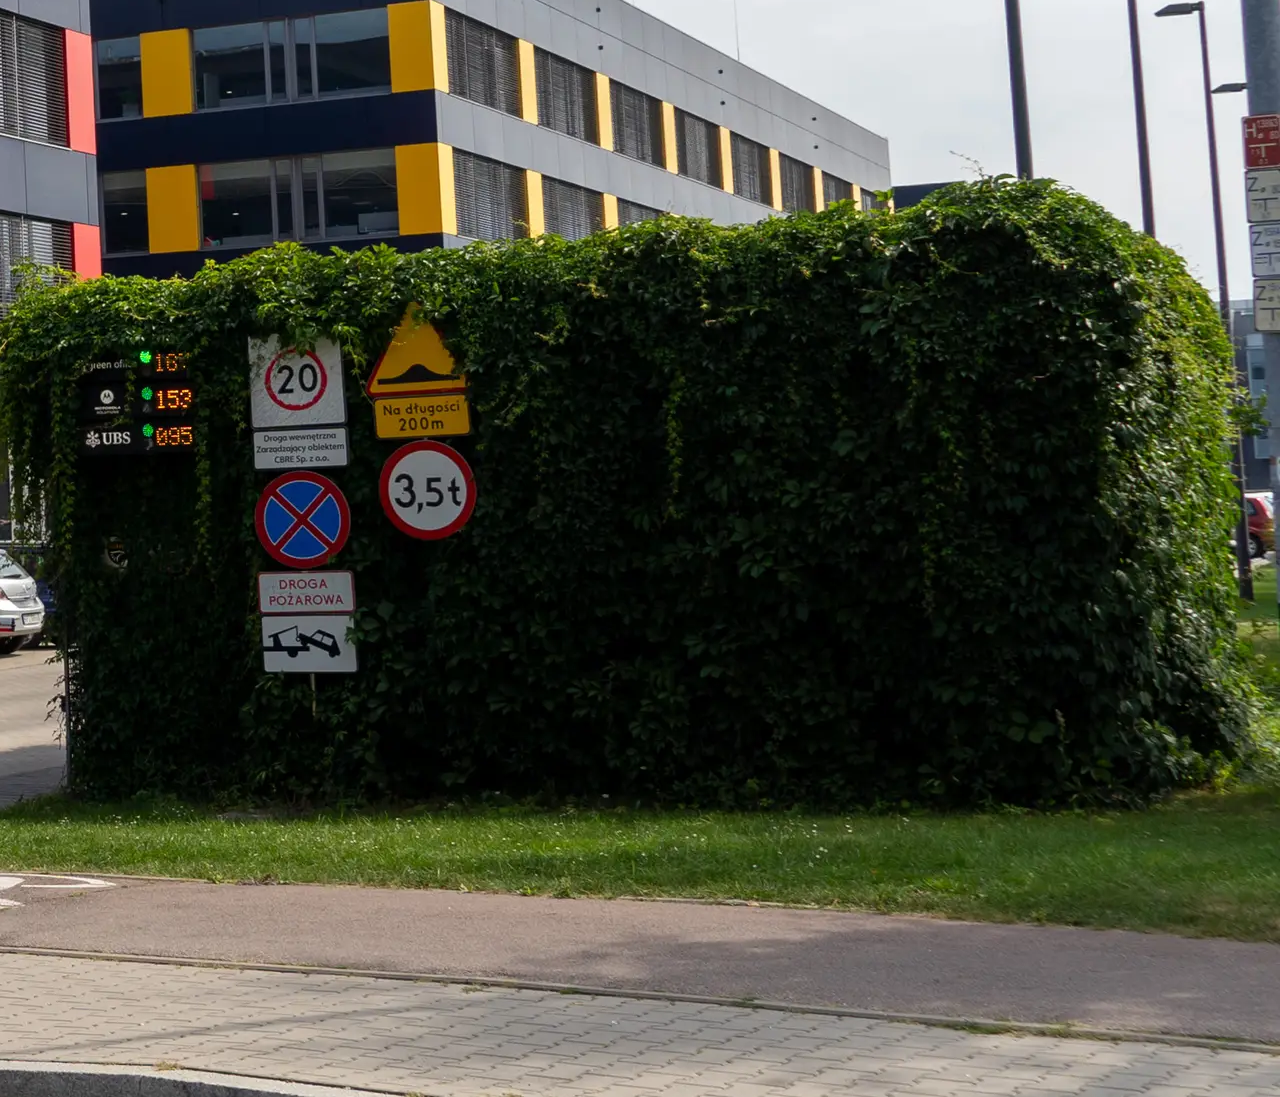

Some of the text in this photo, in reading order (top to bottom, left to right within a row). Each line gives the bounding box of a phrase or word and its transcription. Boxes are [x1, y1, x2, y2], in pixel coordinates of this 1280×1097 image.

[277, 363, 318, 394] 20
[157, 389, 192, 409] 153
[383, 400, 460, 417] Na długości
[101, 431, 131, 445] UBS
[263, 432, 337, 443] Droga wewnętrzna
[307, 442, 345, 452] obiektem
[274, 455, 295, 464] CBRE
[296, 454, 308, 464] Sp.
[279, 579, 328, 590] DROGA
[269, 592, 344, 606] POŻAROWA
